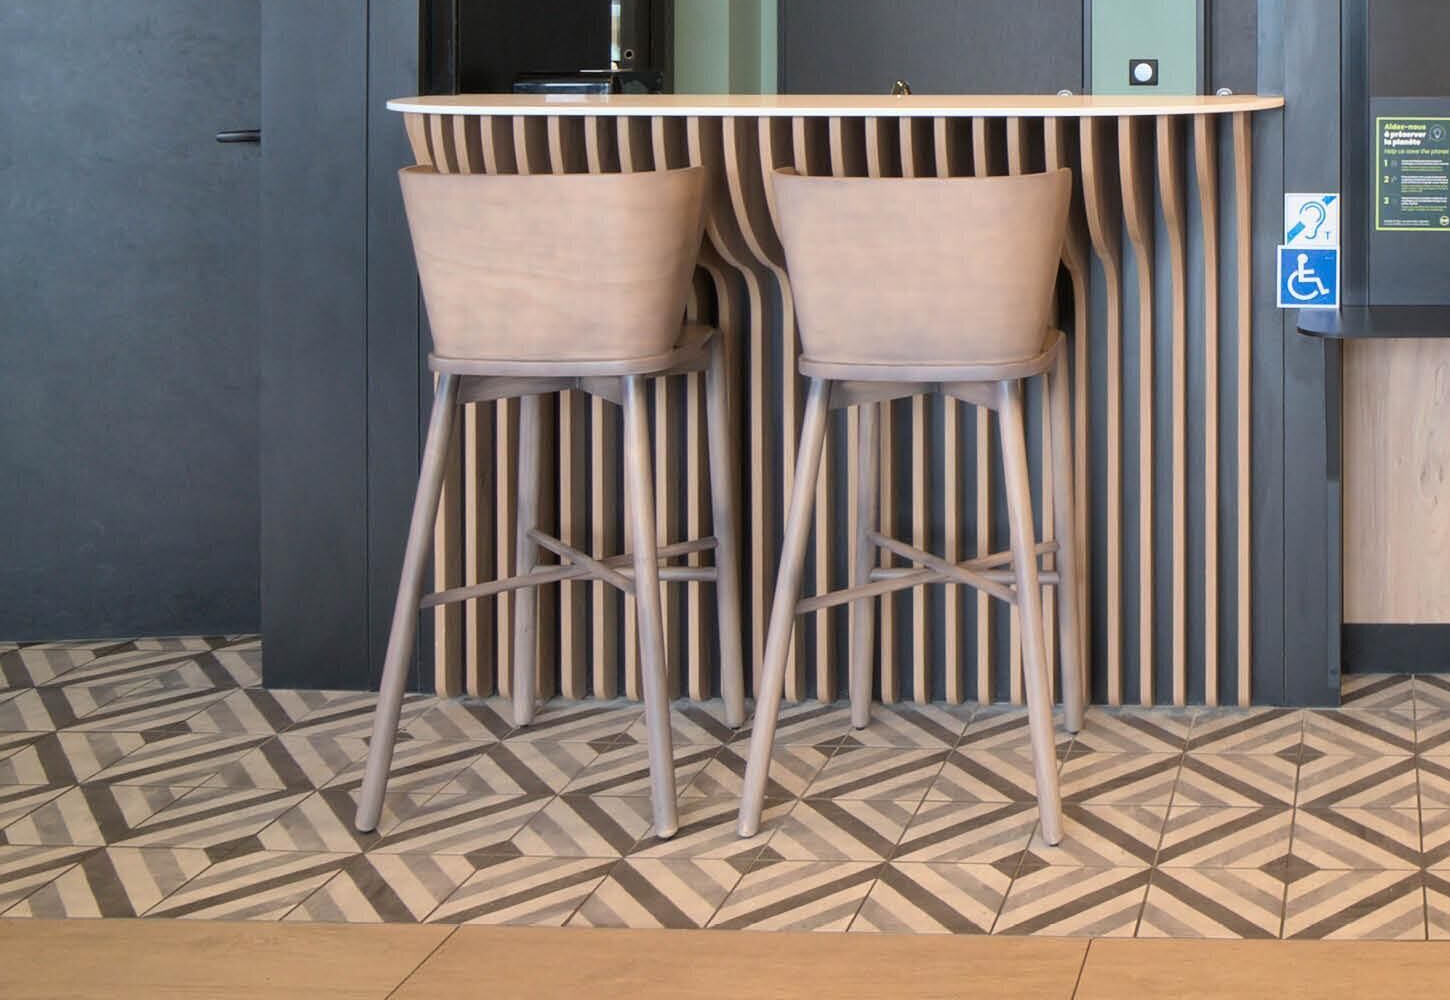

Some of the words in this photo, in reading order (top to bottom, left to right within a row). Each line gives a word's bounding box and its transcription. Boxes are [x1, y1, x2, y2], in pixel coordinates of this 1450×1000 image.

[1390, 130, 1427, 140] préserver
[1383, 138, 1392, 146] la
[1391, 138, 1421, 148] planète
[1383, 175, 1390, 184] 2
[1325, 231, 1331, 241] T
